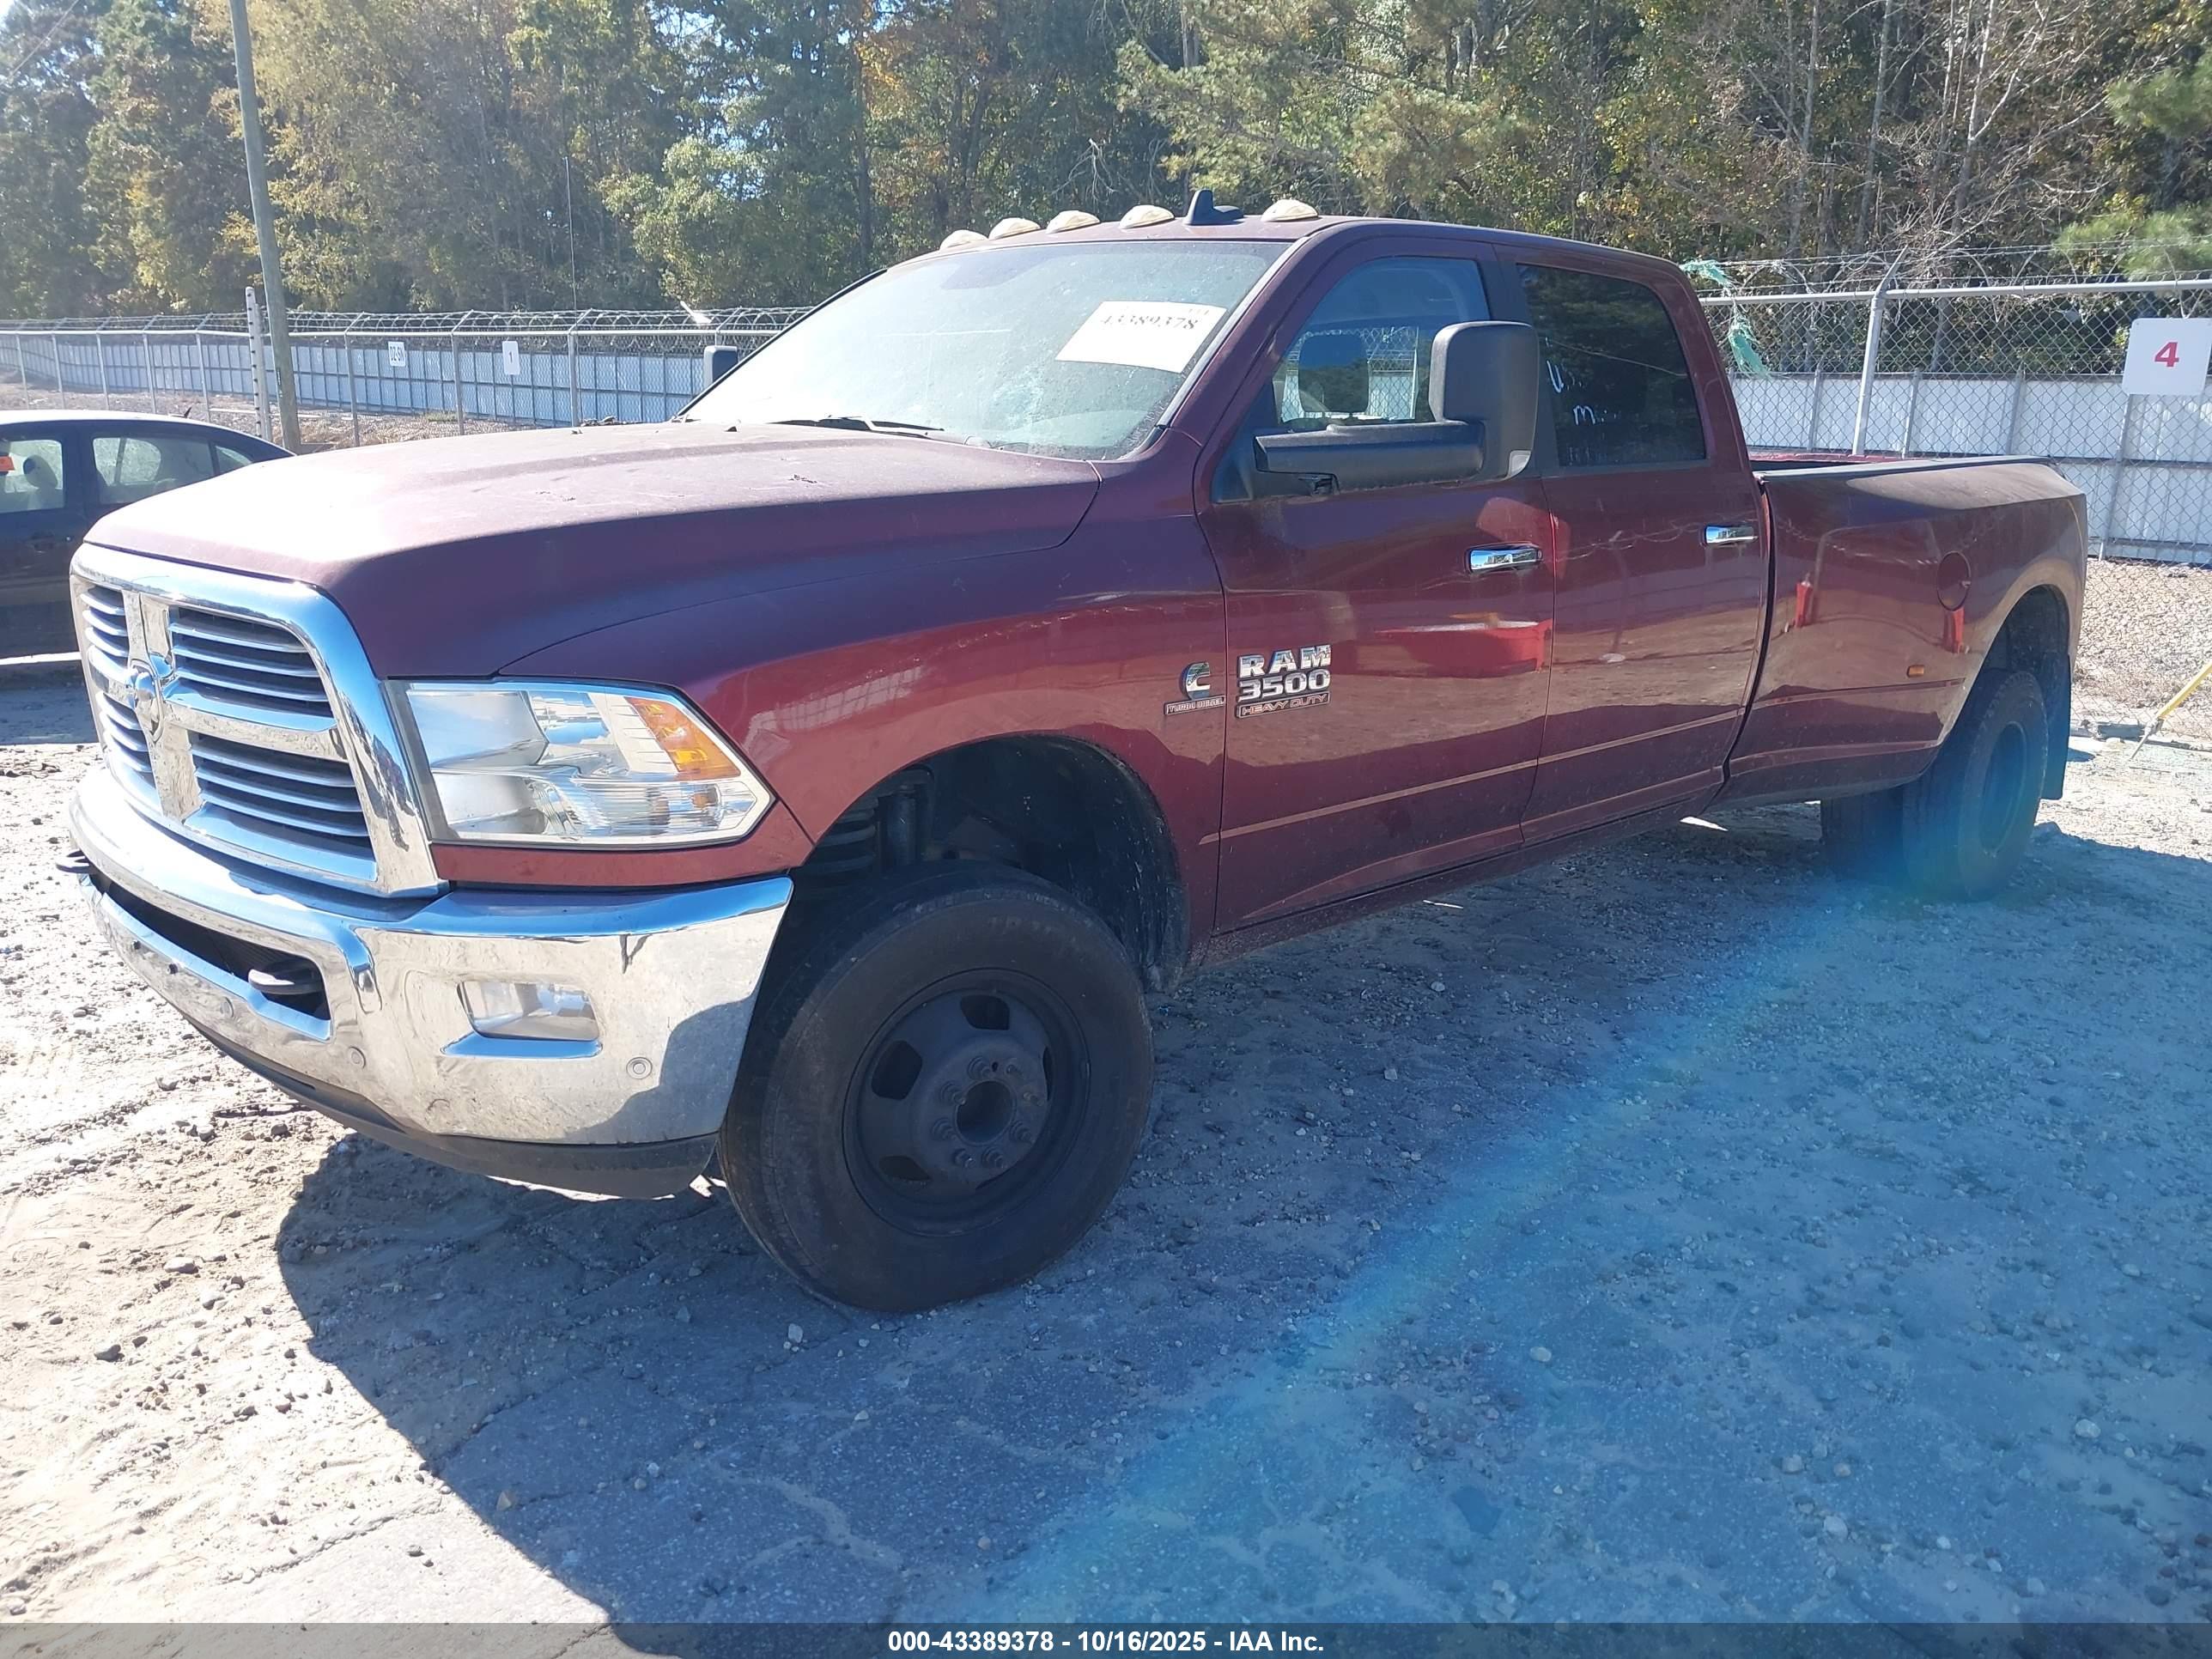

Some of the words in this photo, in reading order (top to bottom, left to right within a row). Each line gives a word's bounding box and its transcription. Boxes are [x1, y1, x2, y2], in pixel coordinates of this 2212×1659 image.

[2154, 341, 2180, 368] 4
[1237, 644, 1332, 678] RAM
[1237, 668, 1331, 702] 3500
[1242, 700, 1291, 716] HEAVY
[1289, 693, 1328, 708] DUTY
